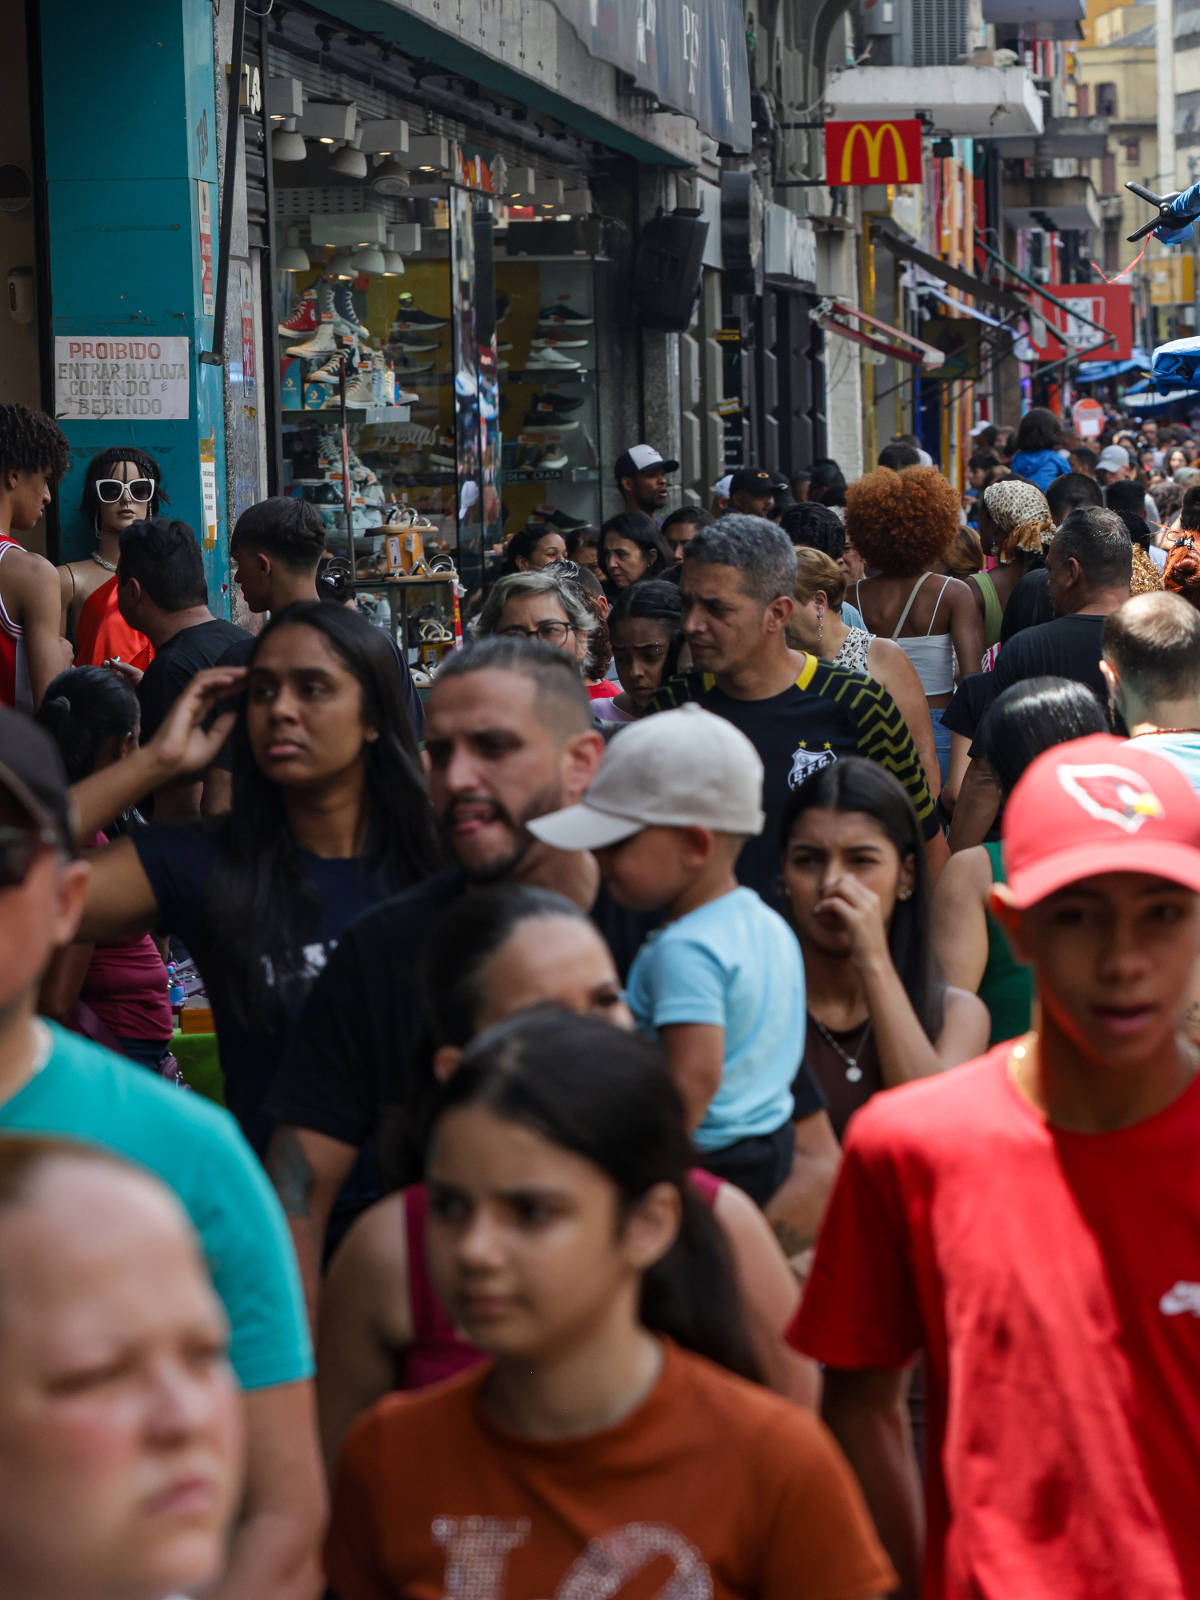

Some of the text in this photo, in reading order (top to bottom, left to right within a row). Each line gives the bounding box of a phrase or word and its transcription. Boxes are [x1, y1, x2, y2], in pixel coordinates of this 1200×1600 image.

[69, 342, 161, 360] PROIBIDO
[58, 362, 188, 380] ENTRAR NA LOJA
[70, 381, 168, 397] COMENDO E
[79, 398, 162, 416] BEBENDO
